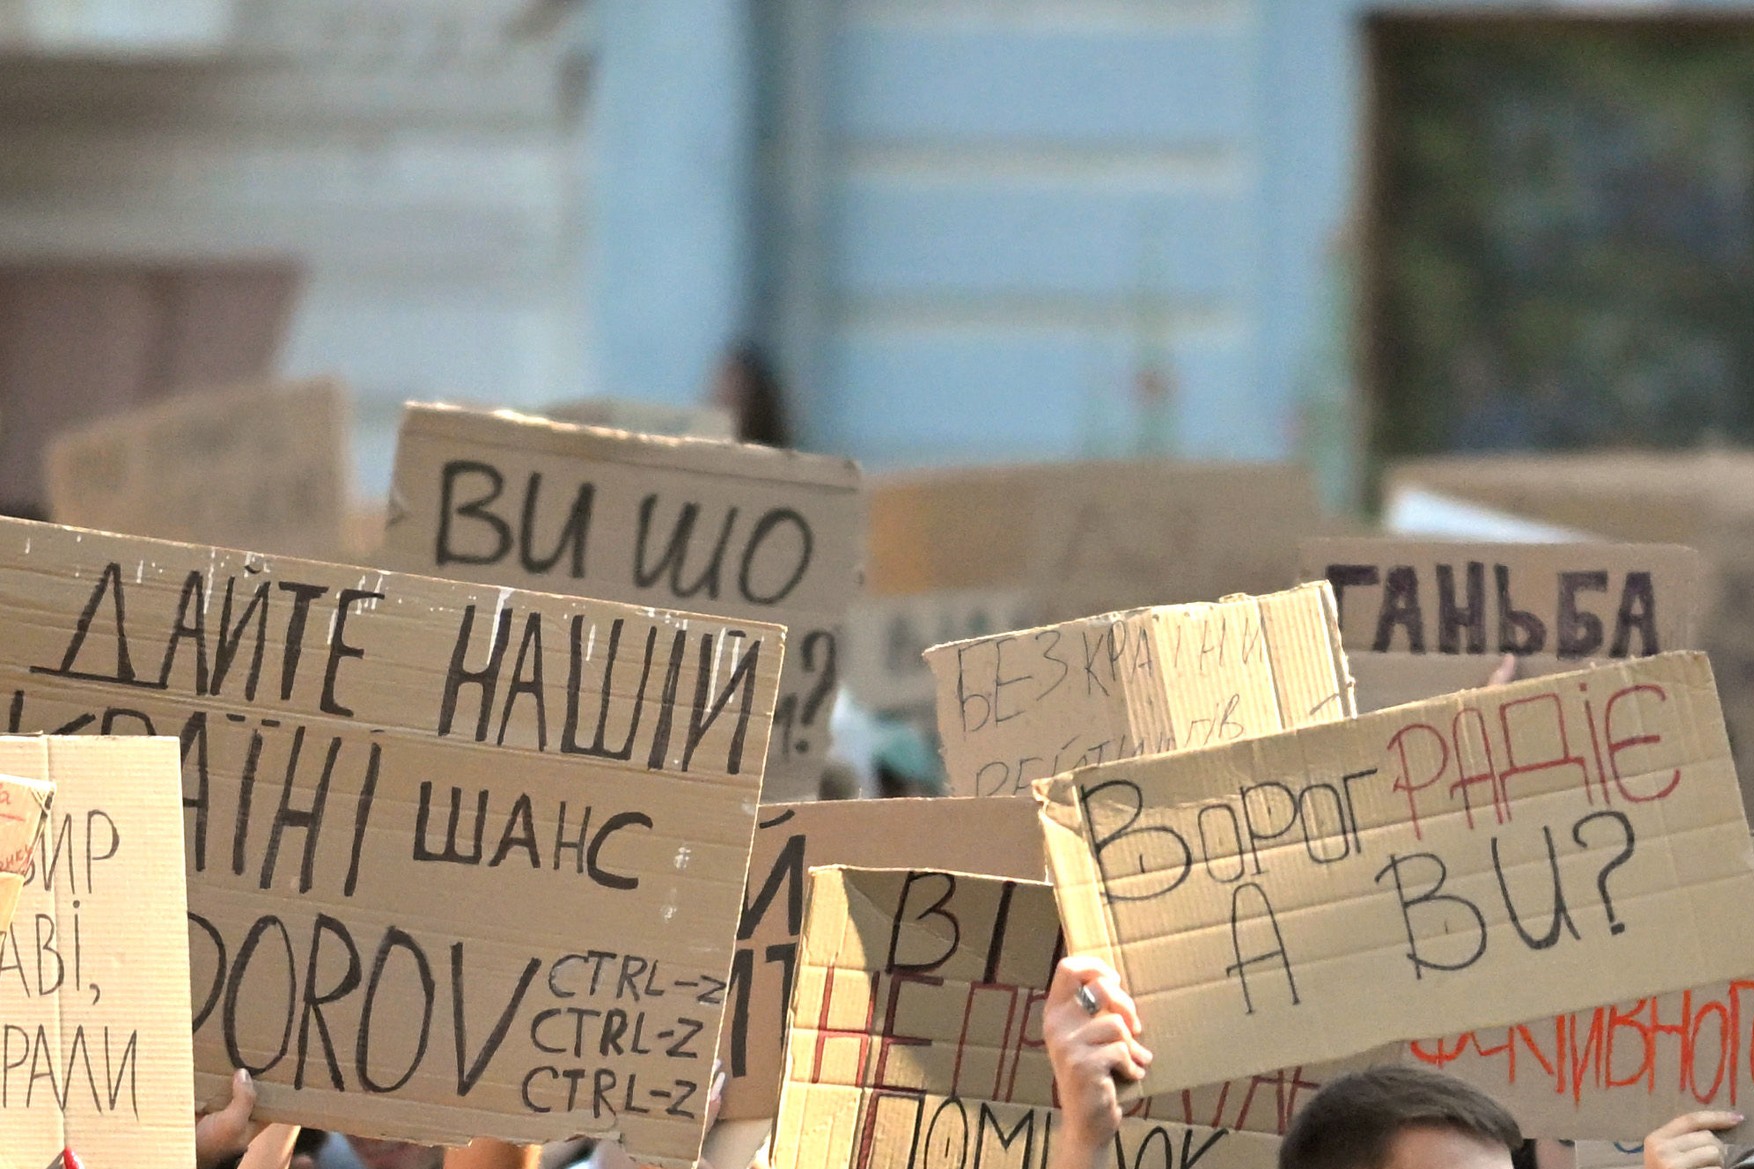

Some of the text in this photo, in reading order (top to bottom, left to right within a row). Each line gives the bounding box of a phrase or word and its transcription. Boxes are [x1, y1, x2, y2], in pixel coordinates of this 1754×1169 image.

[434, 459, 592, 578] ВИ
[634, 491, 815, 604] ШО
[31, 550, 386, 717] ДАЙТЕ
[439, 604, 761, 774] НАШІЙ
[1325, 561, 1661, 659] ГАНЬБА
[957, 629, 1069, 734] БЕЗ
[8, 690, 383, 897] АЇНІ
[975, 693, 1244, 798] РЕГІВ
[1387, 683, 1682, 842] РАДІЄ
[24, 807, 120, 894] ИР
[413, 781, 654, 890] ШАНС
[1226, 810, 1636, 1015] А ВИ?
[549, 950, 728, 1005] CTRL-Z
[530, 1007, 704, 1060] CTRL-Z
[521, 1065, 698, 1120] CTRL-Z
